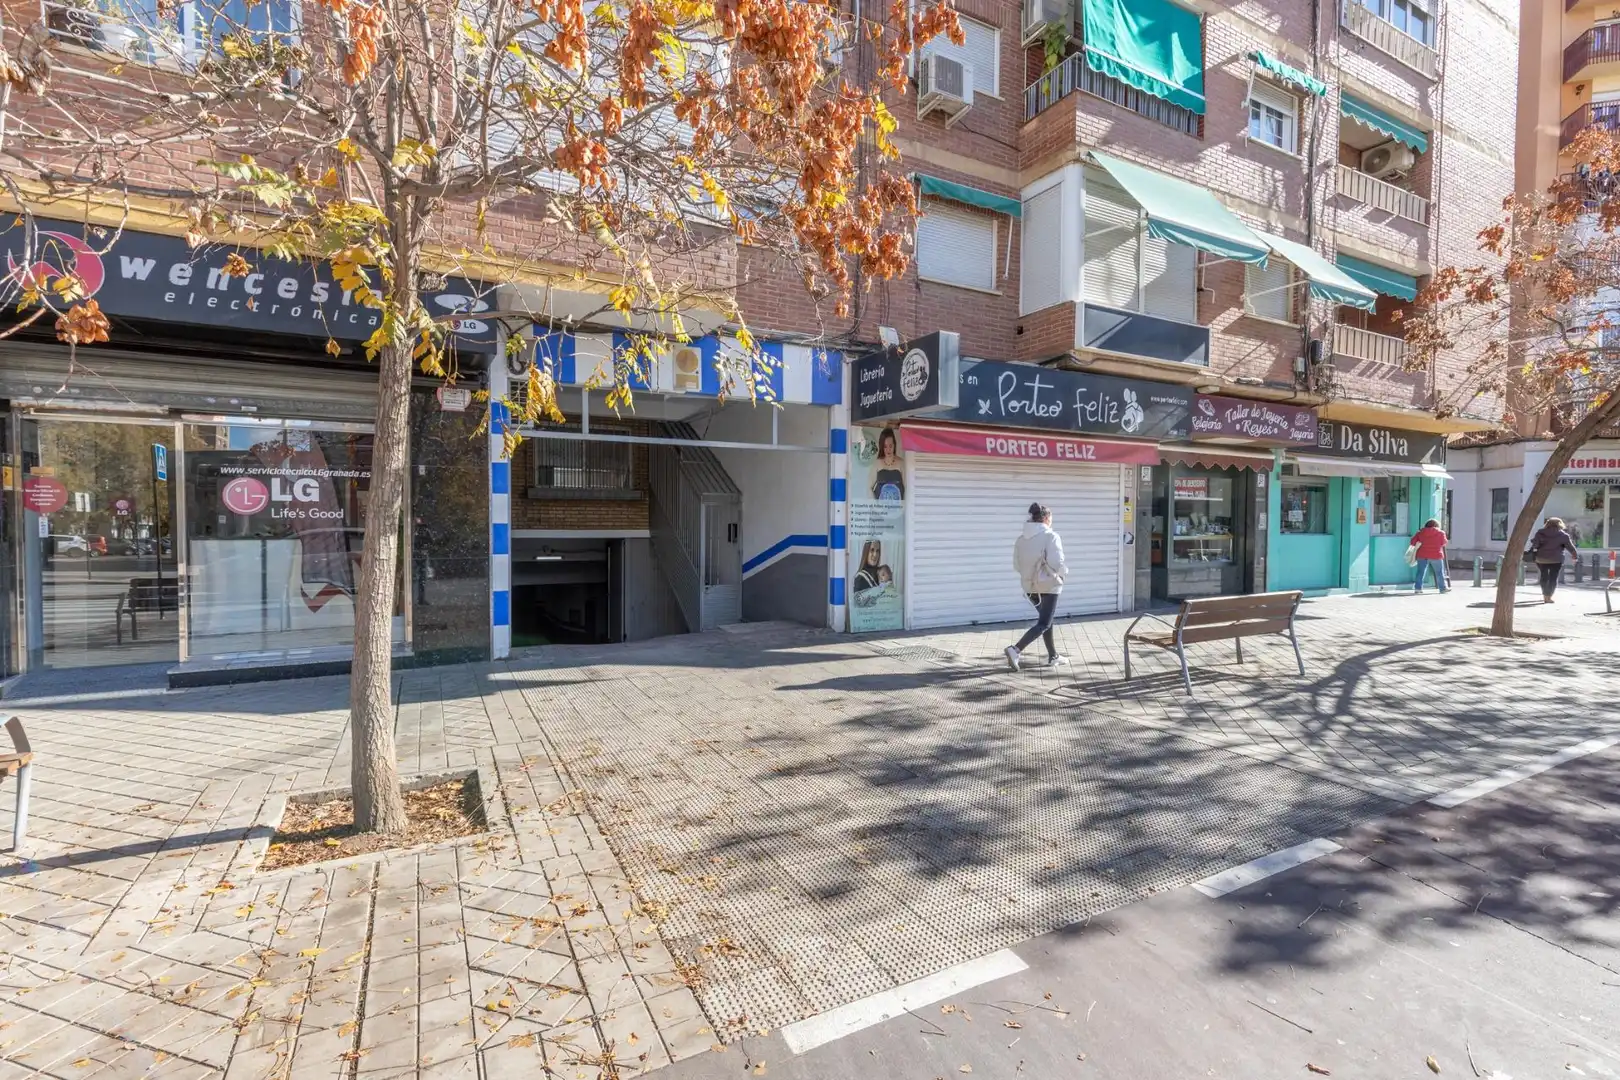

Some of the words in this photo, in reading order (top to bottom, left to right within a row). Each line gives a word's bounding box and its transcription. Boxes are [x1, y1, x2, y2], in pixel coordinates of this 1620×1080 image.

[463, 321, 477, 330] LG
[860, 364, 885, 383] Librería
[967, 375, 978, 385] en
[859, 387, 893, 409] Juguetería
[998, 371, 1063, 417] Porteo
[1225, 404, 1248, 423] Taller
[1250, 406, 1261, 418] de
[1241, 420, 1273, 437] Reyes
[985, 437, 1048, 457] PORTEO
[1056, 442, 1096, 459] FELIZ
[1340, 425, 1363, 451] Da
[1368, 429, 1408, 456] Silva
[271, 477, 320, 503] LG
[271, 508, 306, 519] Life's
[308, 507, 344, 519] Good
